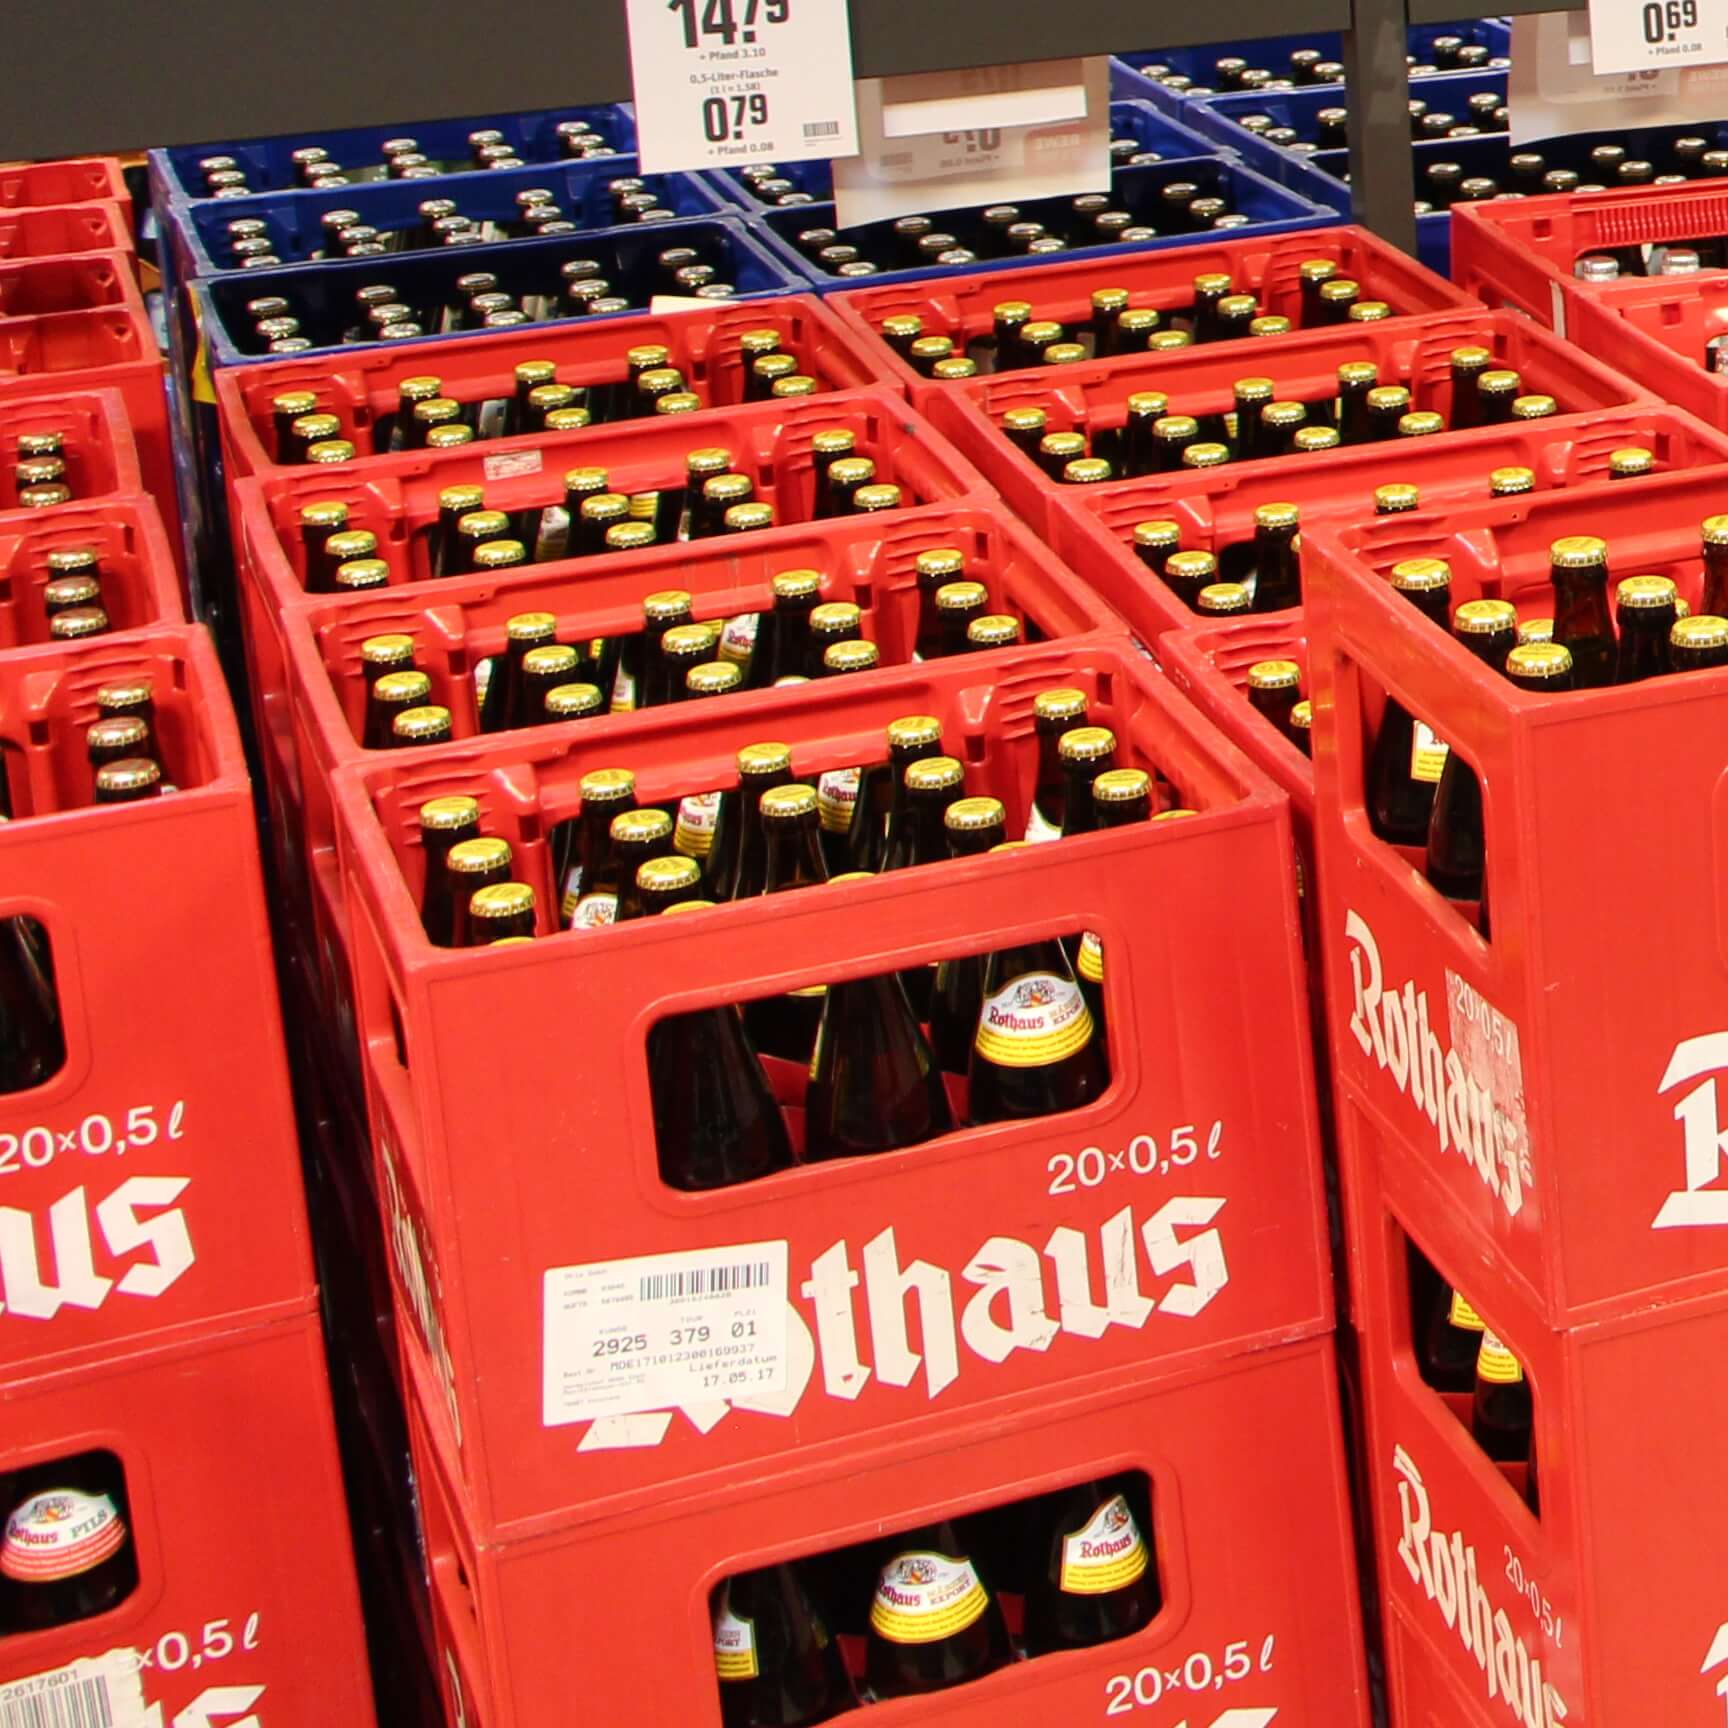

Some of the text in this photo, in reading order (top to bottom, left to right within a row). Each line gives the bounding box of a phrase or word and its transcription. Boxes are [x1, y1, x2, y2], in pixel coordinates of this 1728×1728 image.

[989, 1006, 1045, 1031] Rothaus
[1345, 907, 1525, 1218] Rothaus
[577, 1195, 1227, 1453] thaus
[592, 1334, 648, 1358] 2925
[670, 1326, 711, 1346] 379
[689, 1354, 777, 1372] Lieferdatum
[703, 1368, 774, 1388] 17.05.17
[70, 1509, 109, 1539] PILS
[1079, 1534, 1132, 1560] Rothaus
